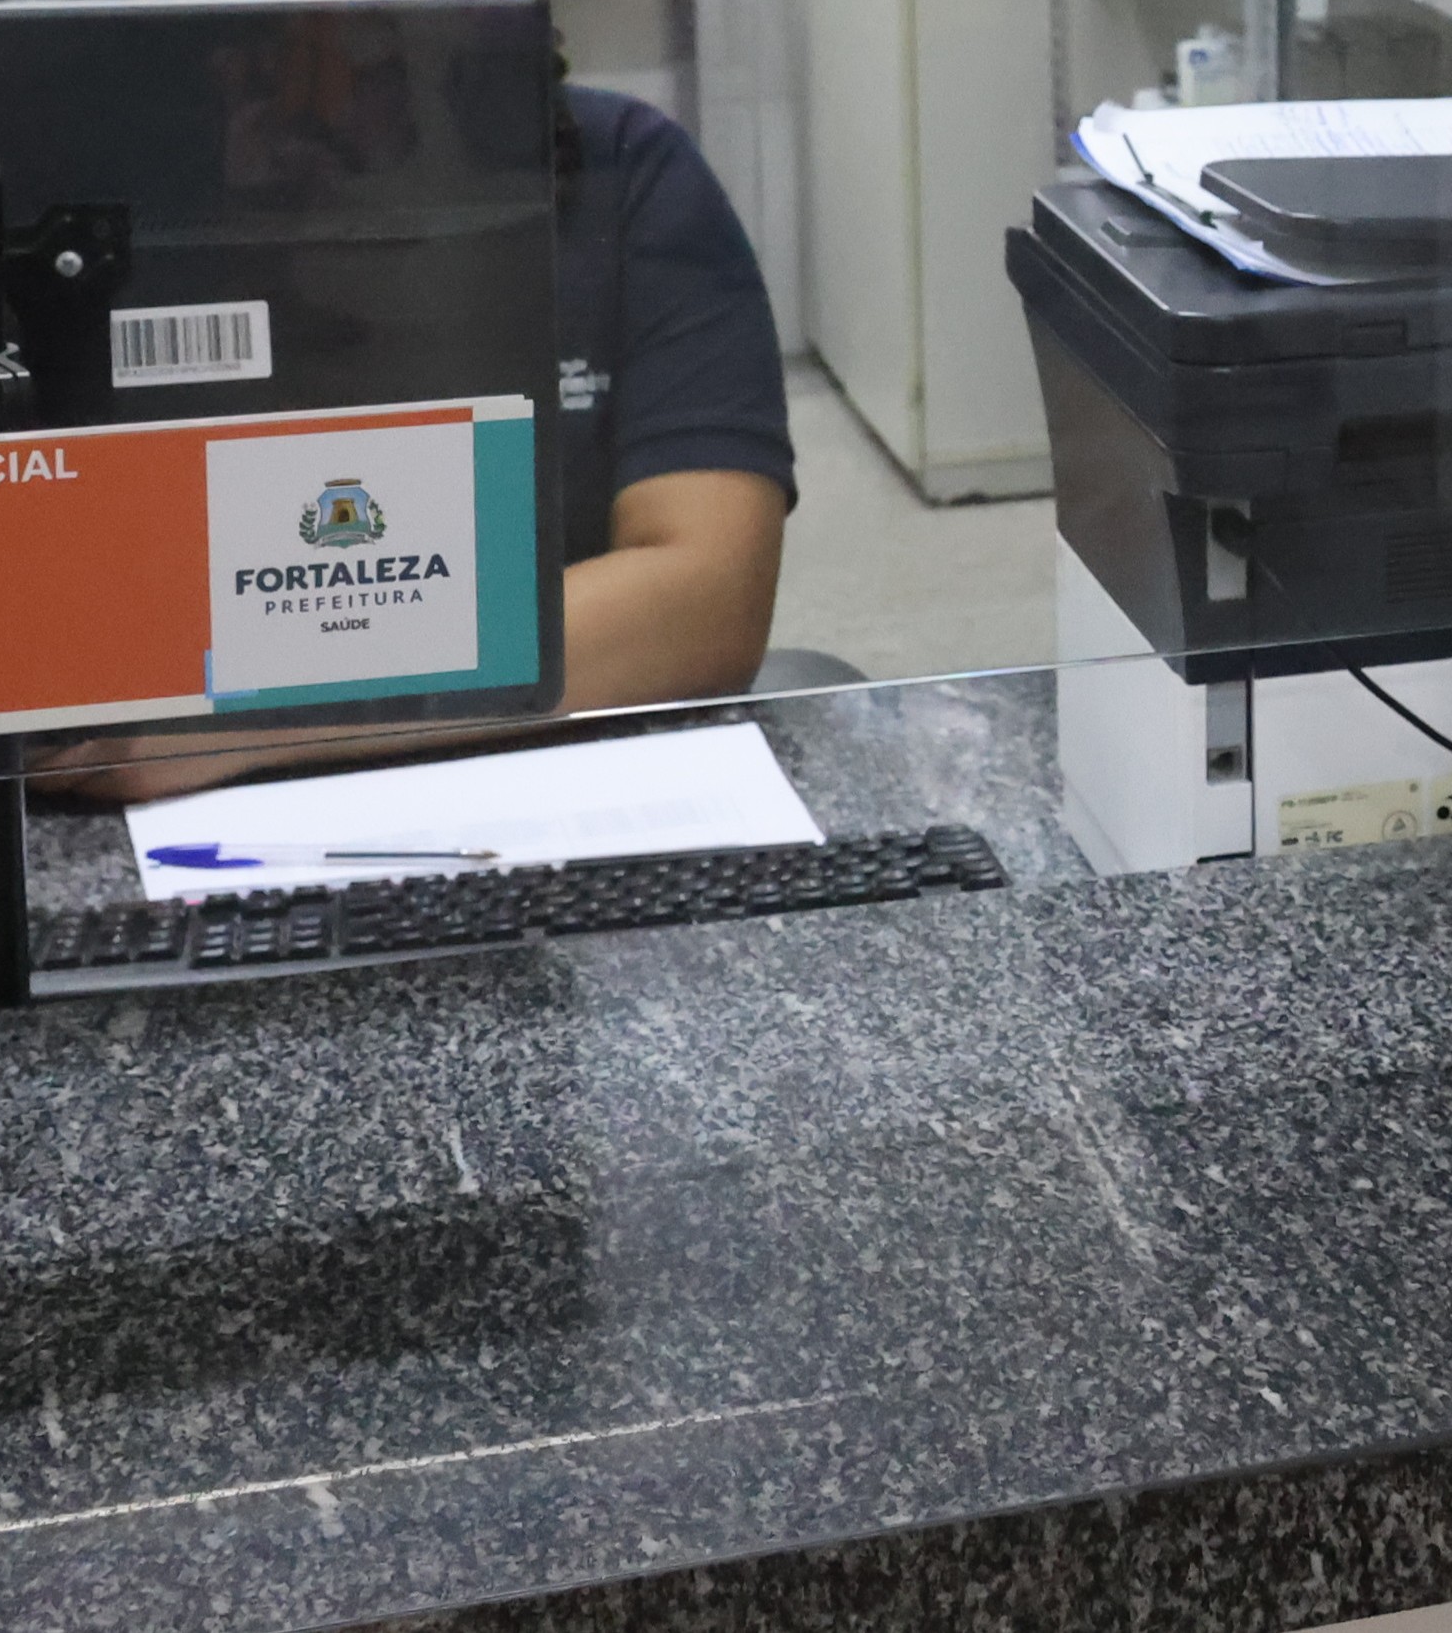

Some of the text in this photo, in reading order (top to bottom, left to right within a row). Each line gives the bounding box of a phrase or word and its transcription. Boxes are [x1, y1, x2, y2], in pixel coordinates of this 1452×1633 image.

[234, 553, 451, 595] FORTALEZA
[264, 589, 423, 616] PREFEITURA
[319, 617, 371, 633] SAÚDE
